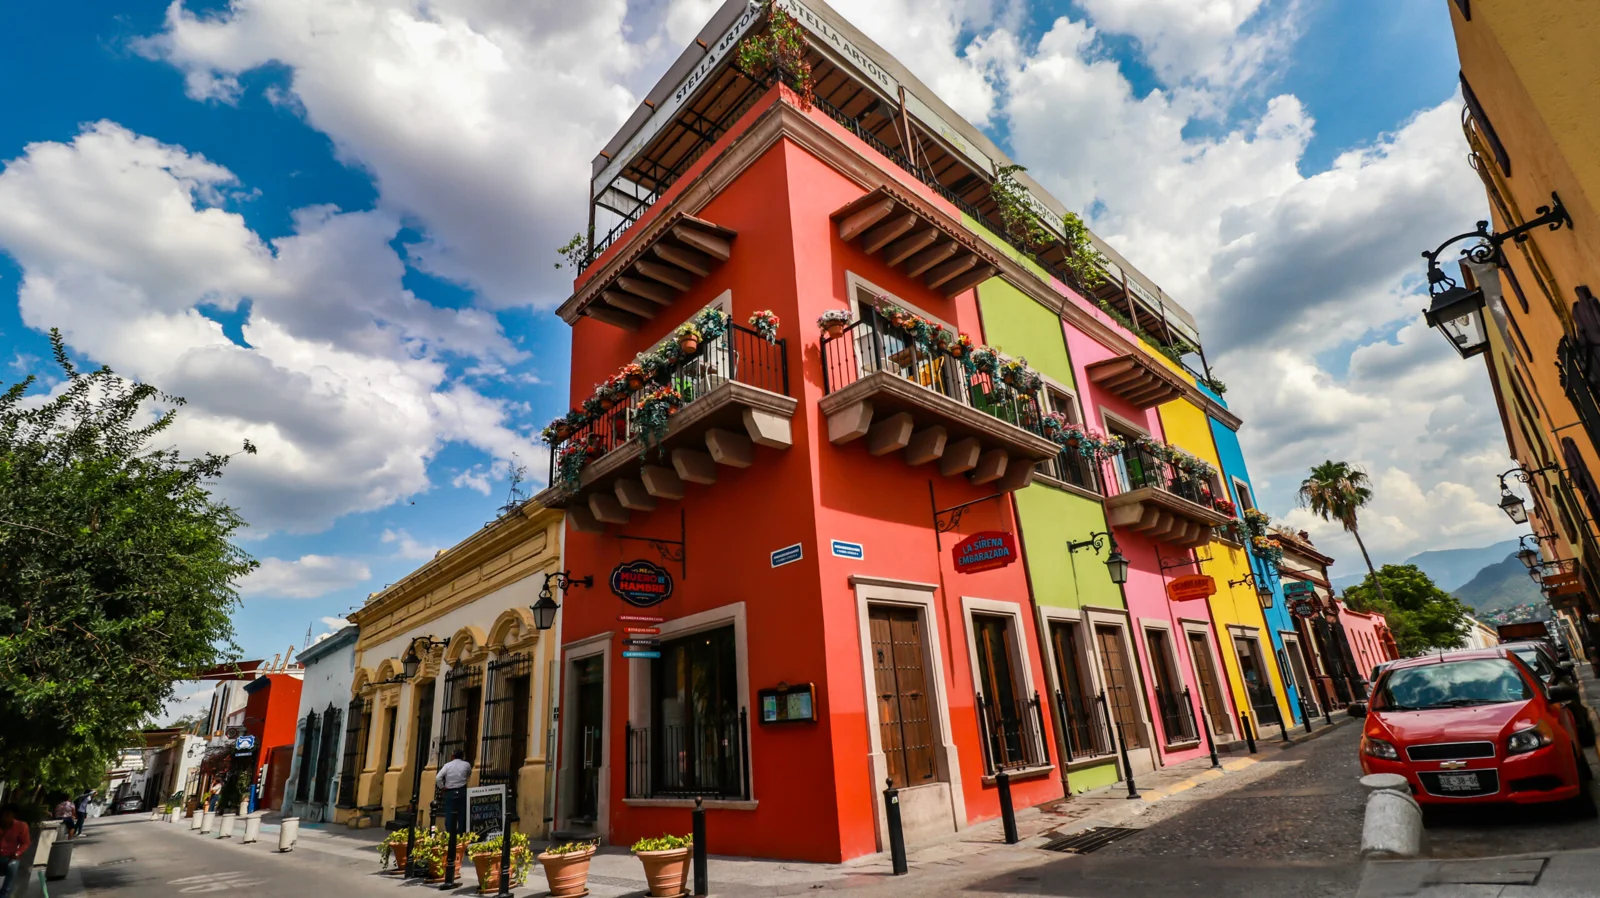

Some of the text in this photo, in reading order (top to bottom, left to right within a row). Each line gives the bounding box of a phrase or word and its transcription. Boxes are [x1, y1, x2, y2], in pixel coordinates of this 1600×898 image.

[789, 0, 889, 86] STELLA ARTOIS
[675, 54, 716, 104] STELLA
[962, 538, 1003, 555] LA SIRENA
[958, 546, 1010, 566] EMBARAZADA
[620, 572, 658, 583] MUERO
[620, 581, 665, 593] HAMBRE
